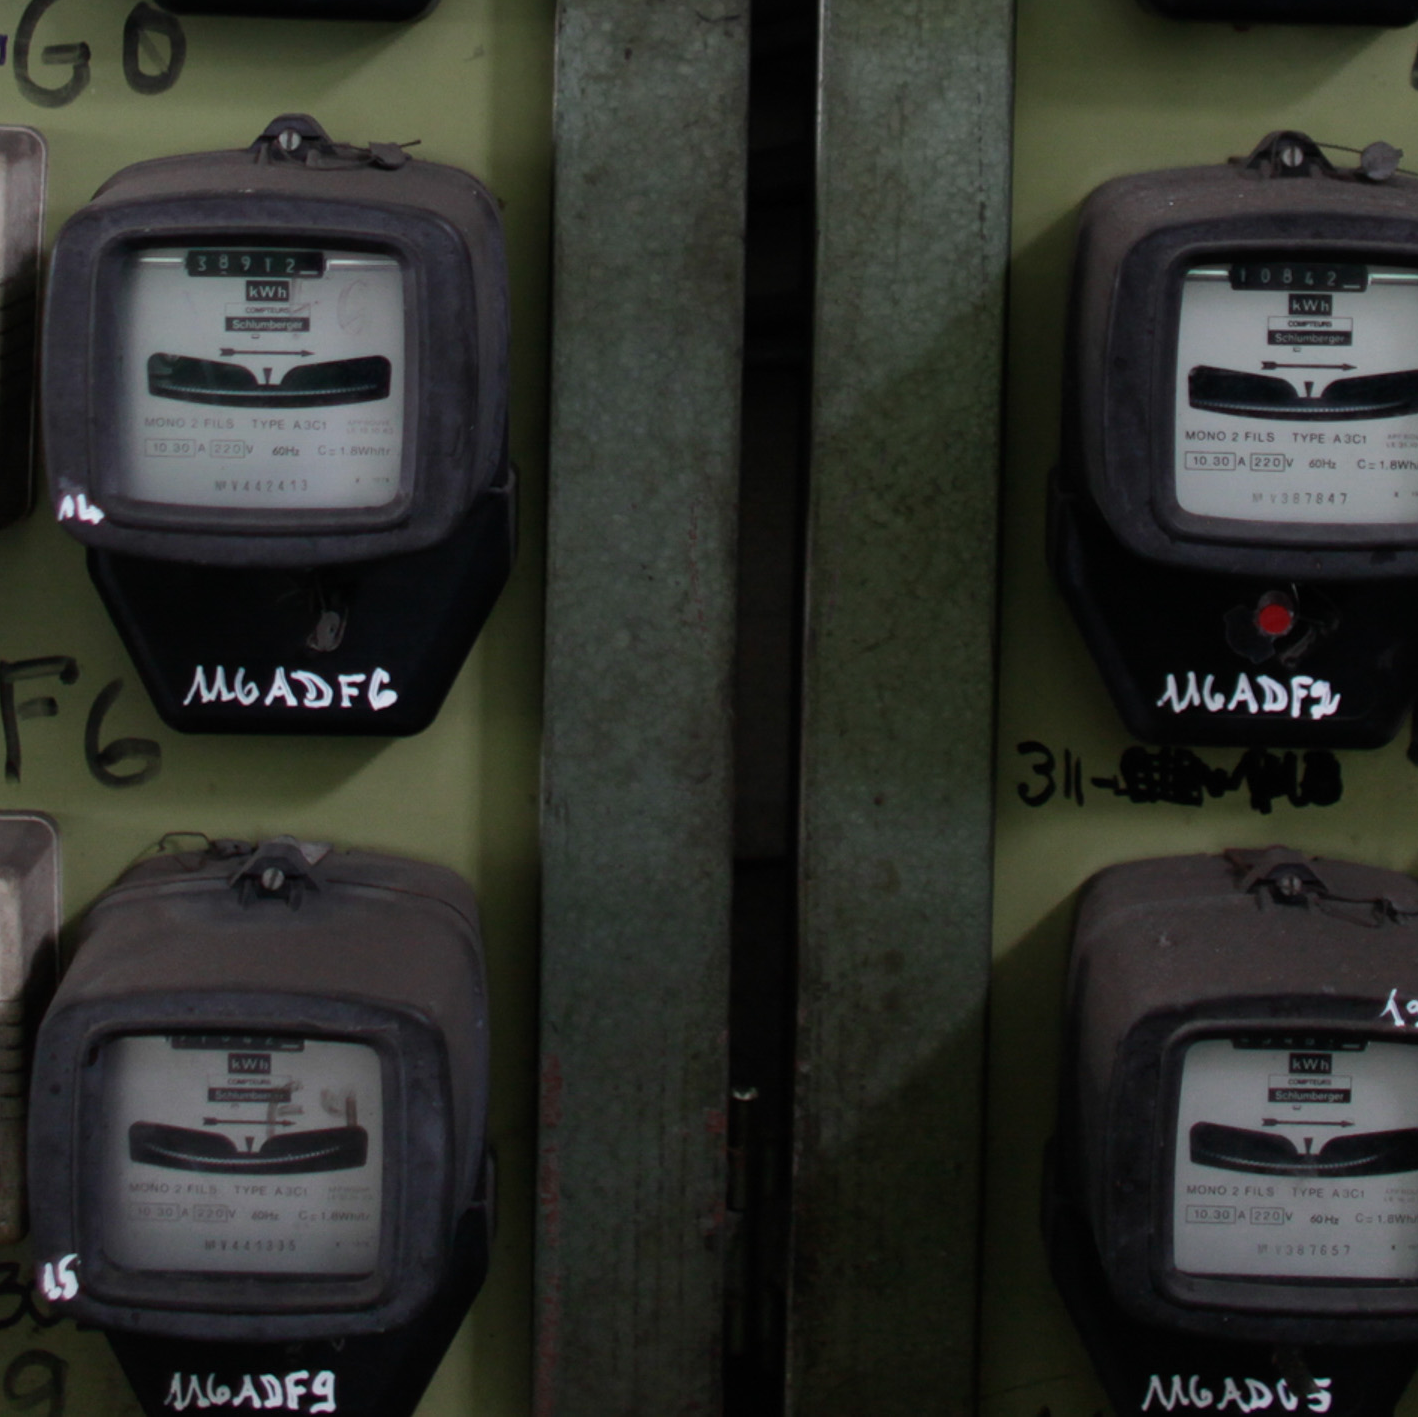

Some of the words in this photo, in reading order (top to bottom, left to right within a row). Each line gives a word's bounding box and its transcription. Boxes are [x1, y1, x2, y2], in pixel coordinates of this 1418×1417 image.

[248, 285, 288, 300] kWh
[1291, 297, 1331, 313] kWh
[231, 318, 304, 332] Schlumberger
[1275, 331, 1346, 345] Schlumberger
[1185, 430, 1228, 442] MONO
[1231, 431, 1240, 442] 2
[1244, 431, 1276, 442] FILS
[1292, 432, 1326, 443] TYPE
[1254, 456, 1282, 468] 220
[1291, 1057, 1331, 1072] kWh
[1274, 1089, 1345, 1102] Schlumberger
